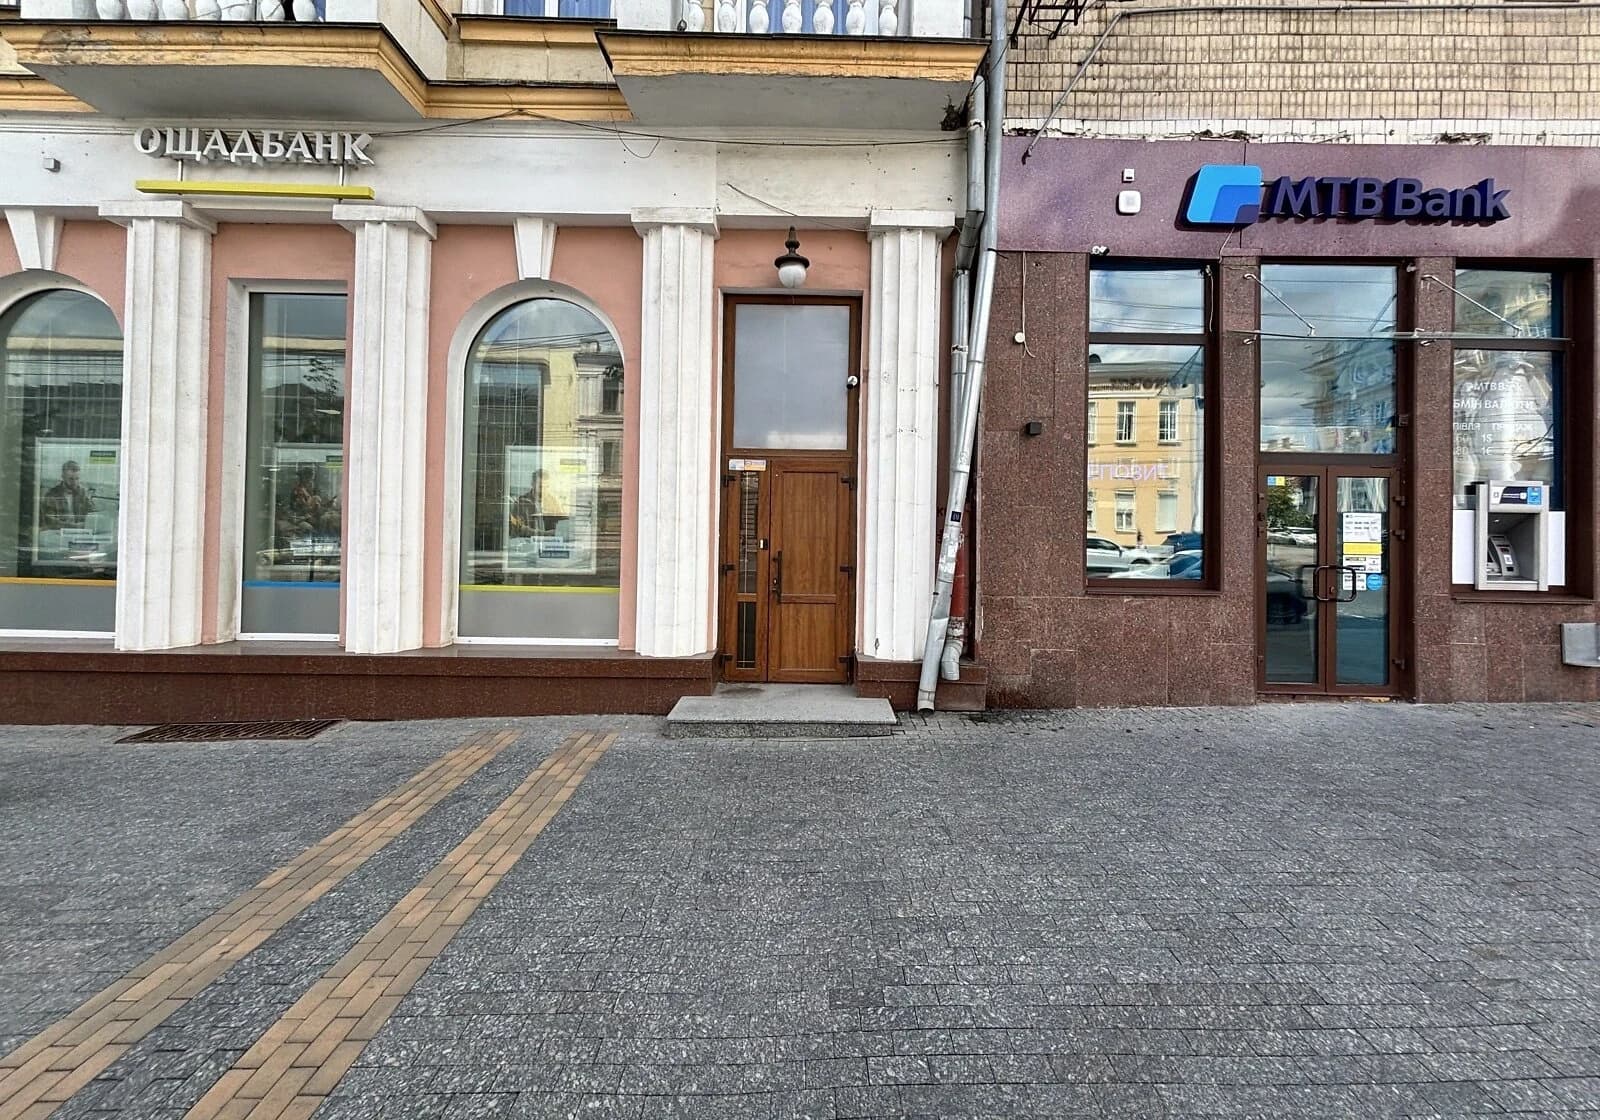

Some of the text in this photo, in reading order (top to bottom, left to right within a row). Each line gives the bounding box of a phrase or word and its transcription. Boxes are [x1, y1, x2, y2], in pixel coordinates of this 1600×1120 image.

[133, 126, 374, 166] ОЩАДБАНК
[1273, 176, 1512, 218] MTB Bank
